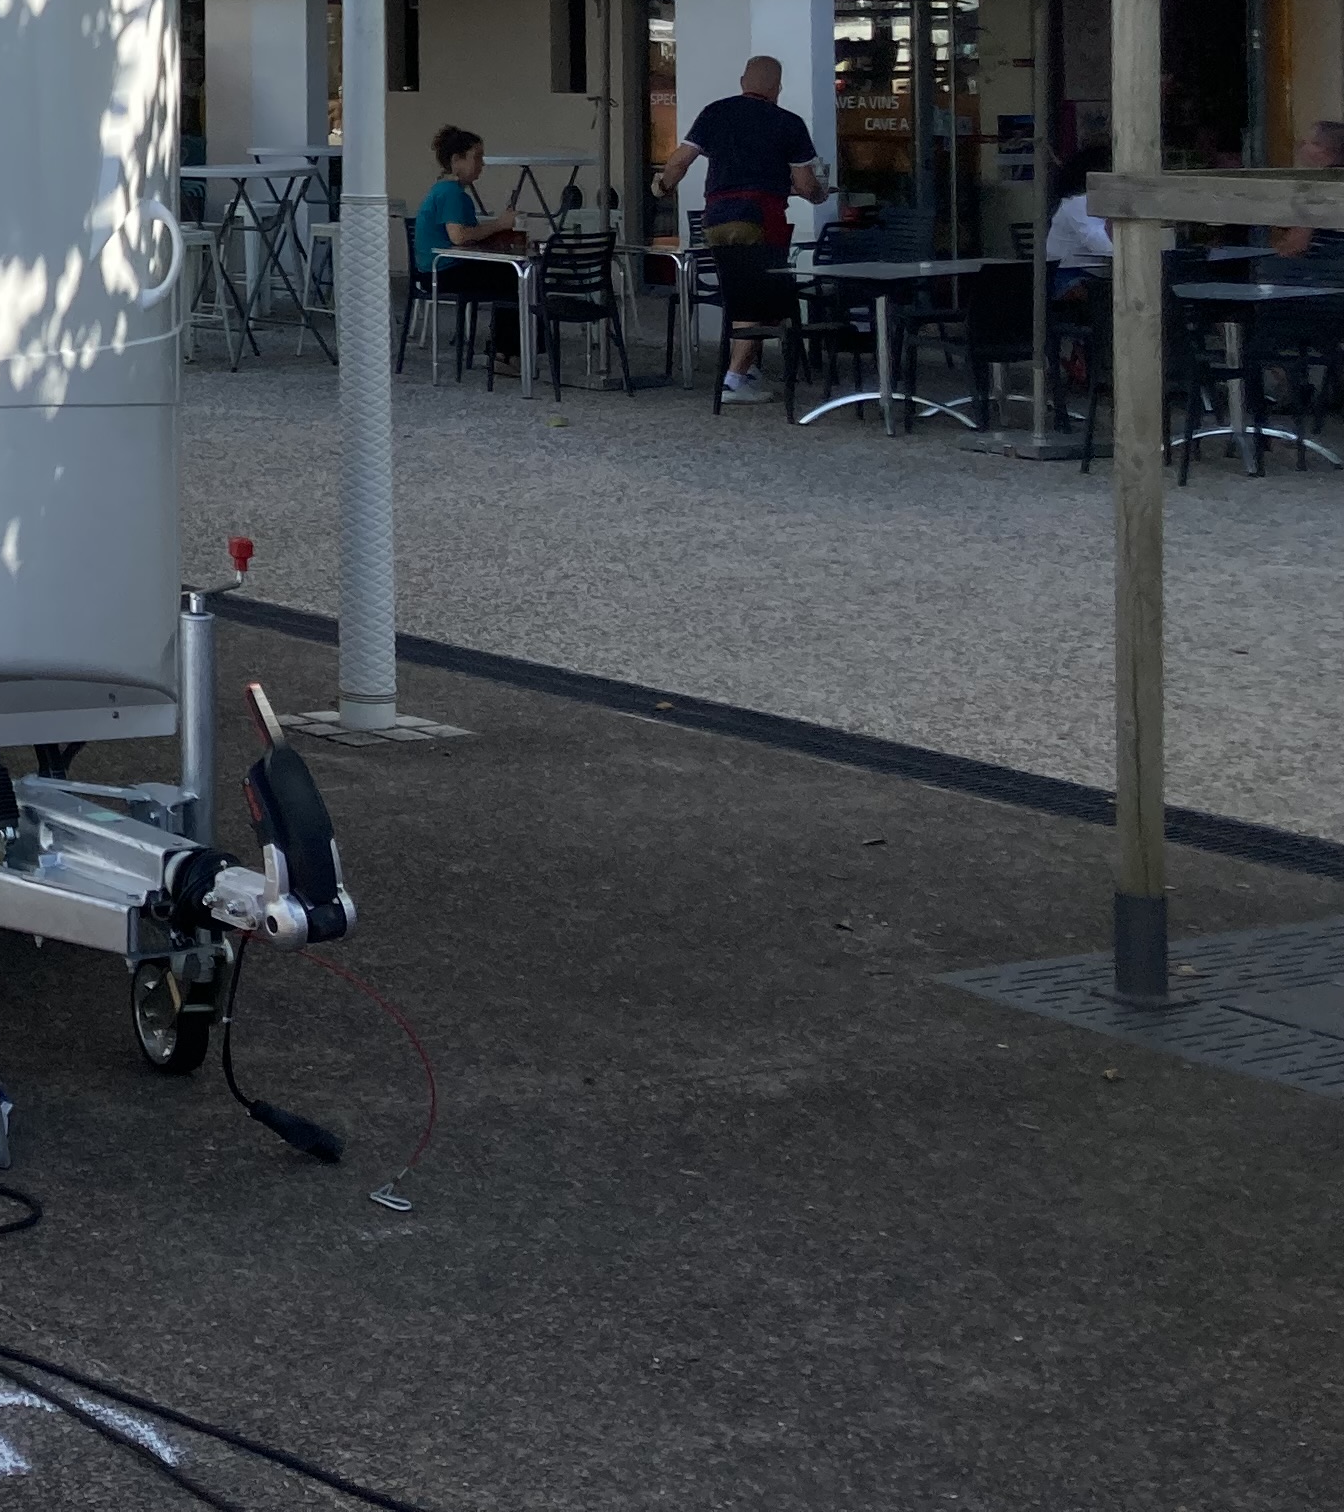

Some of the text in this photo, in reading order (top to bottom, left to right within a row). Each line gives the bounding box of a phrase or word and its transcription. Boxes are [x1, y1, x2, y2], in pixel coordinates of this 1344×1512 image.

[858, 96, 867, 109] A
[869, 96, 900, 109] VINS
[865, 118, 897, 131] CAVE
